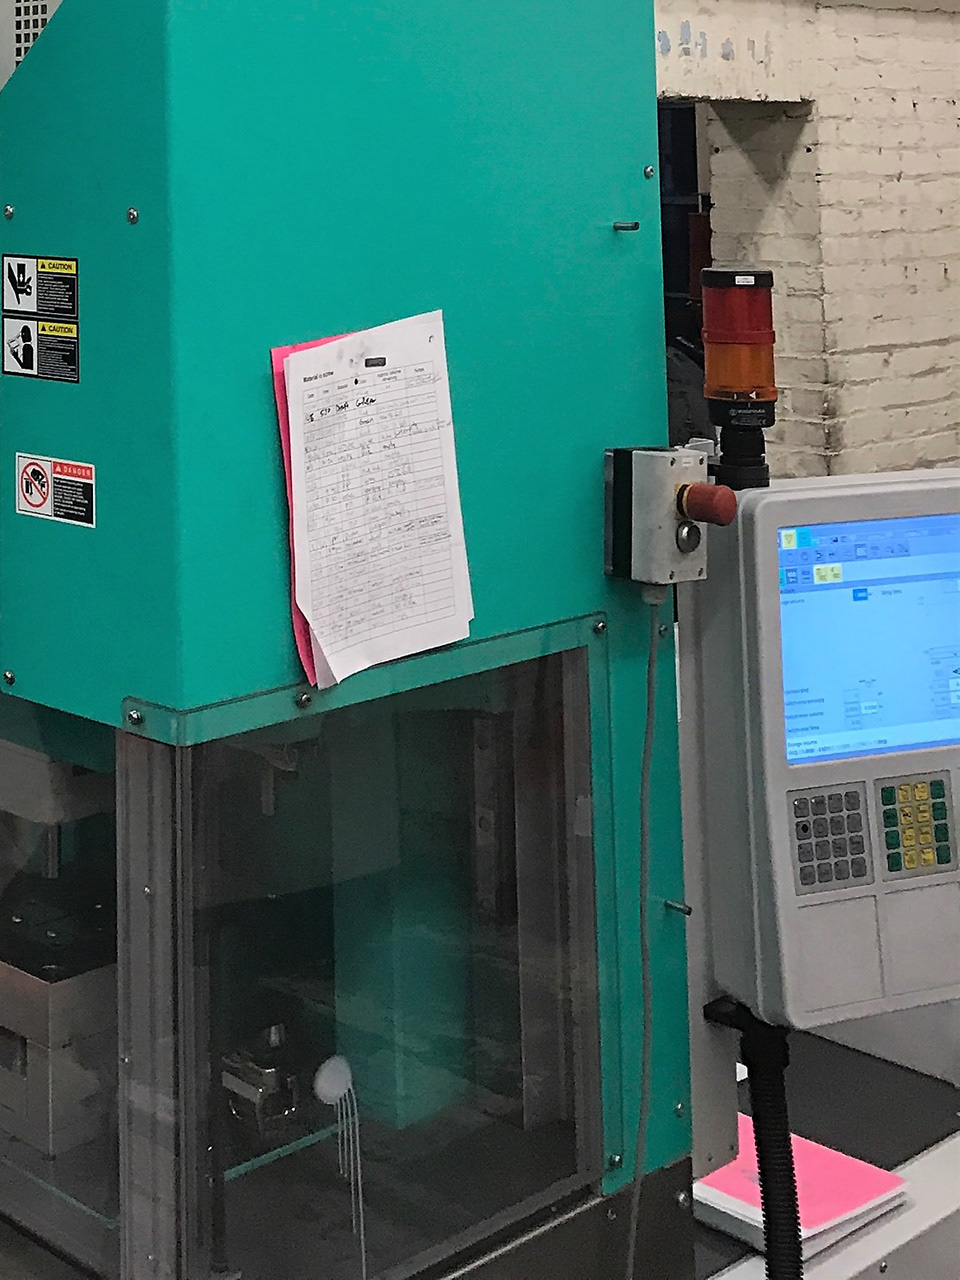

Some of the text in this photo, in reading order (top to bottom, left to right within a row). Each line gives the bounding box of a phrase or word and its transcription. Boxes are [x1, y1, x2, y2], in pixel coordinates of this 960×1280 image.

[48, 262, 73, 271] CAUTION
[48, 324, 74, 334] CAUTION
[63, 465, 91, 477] DANGER
